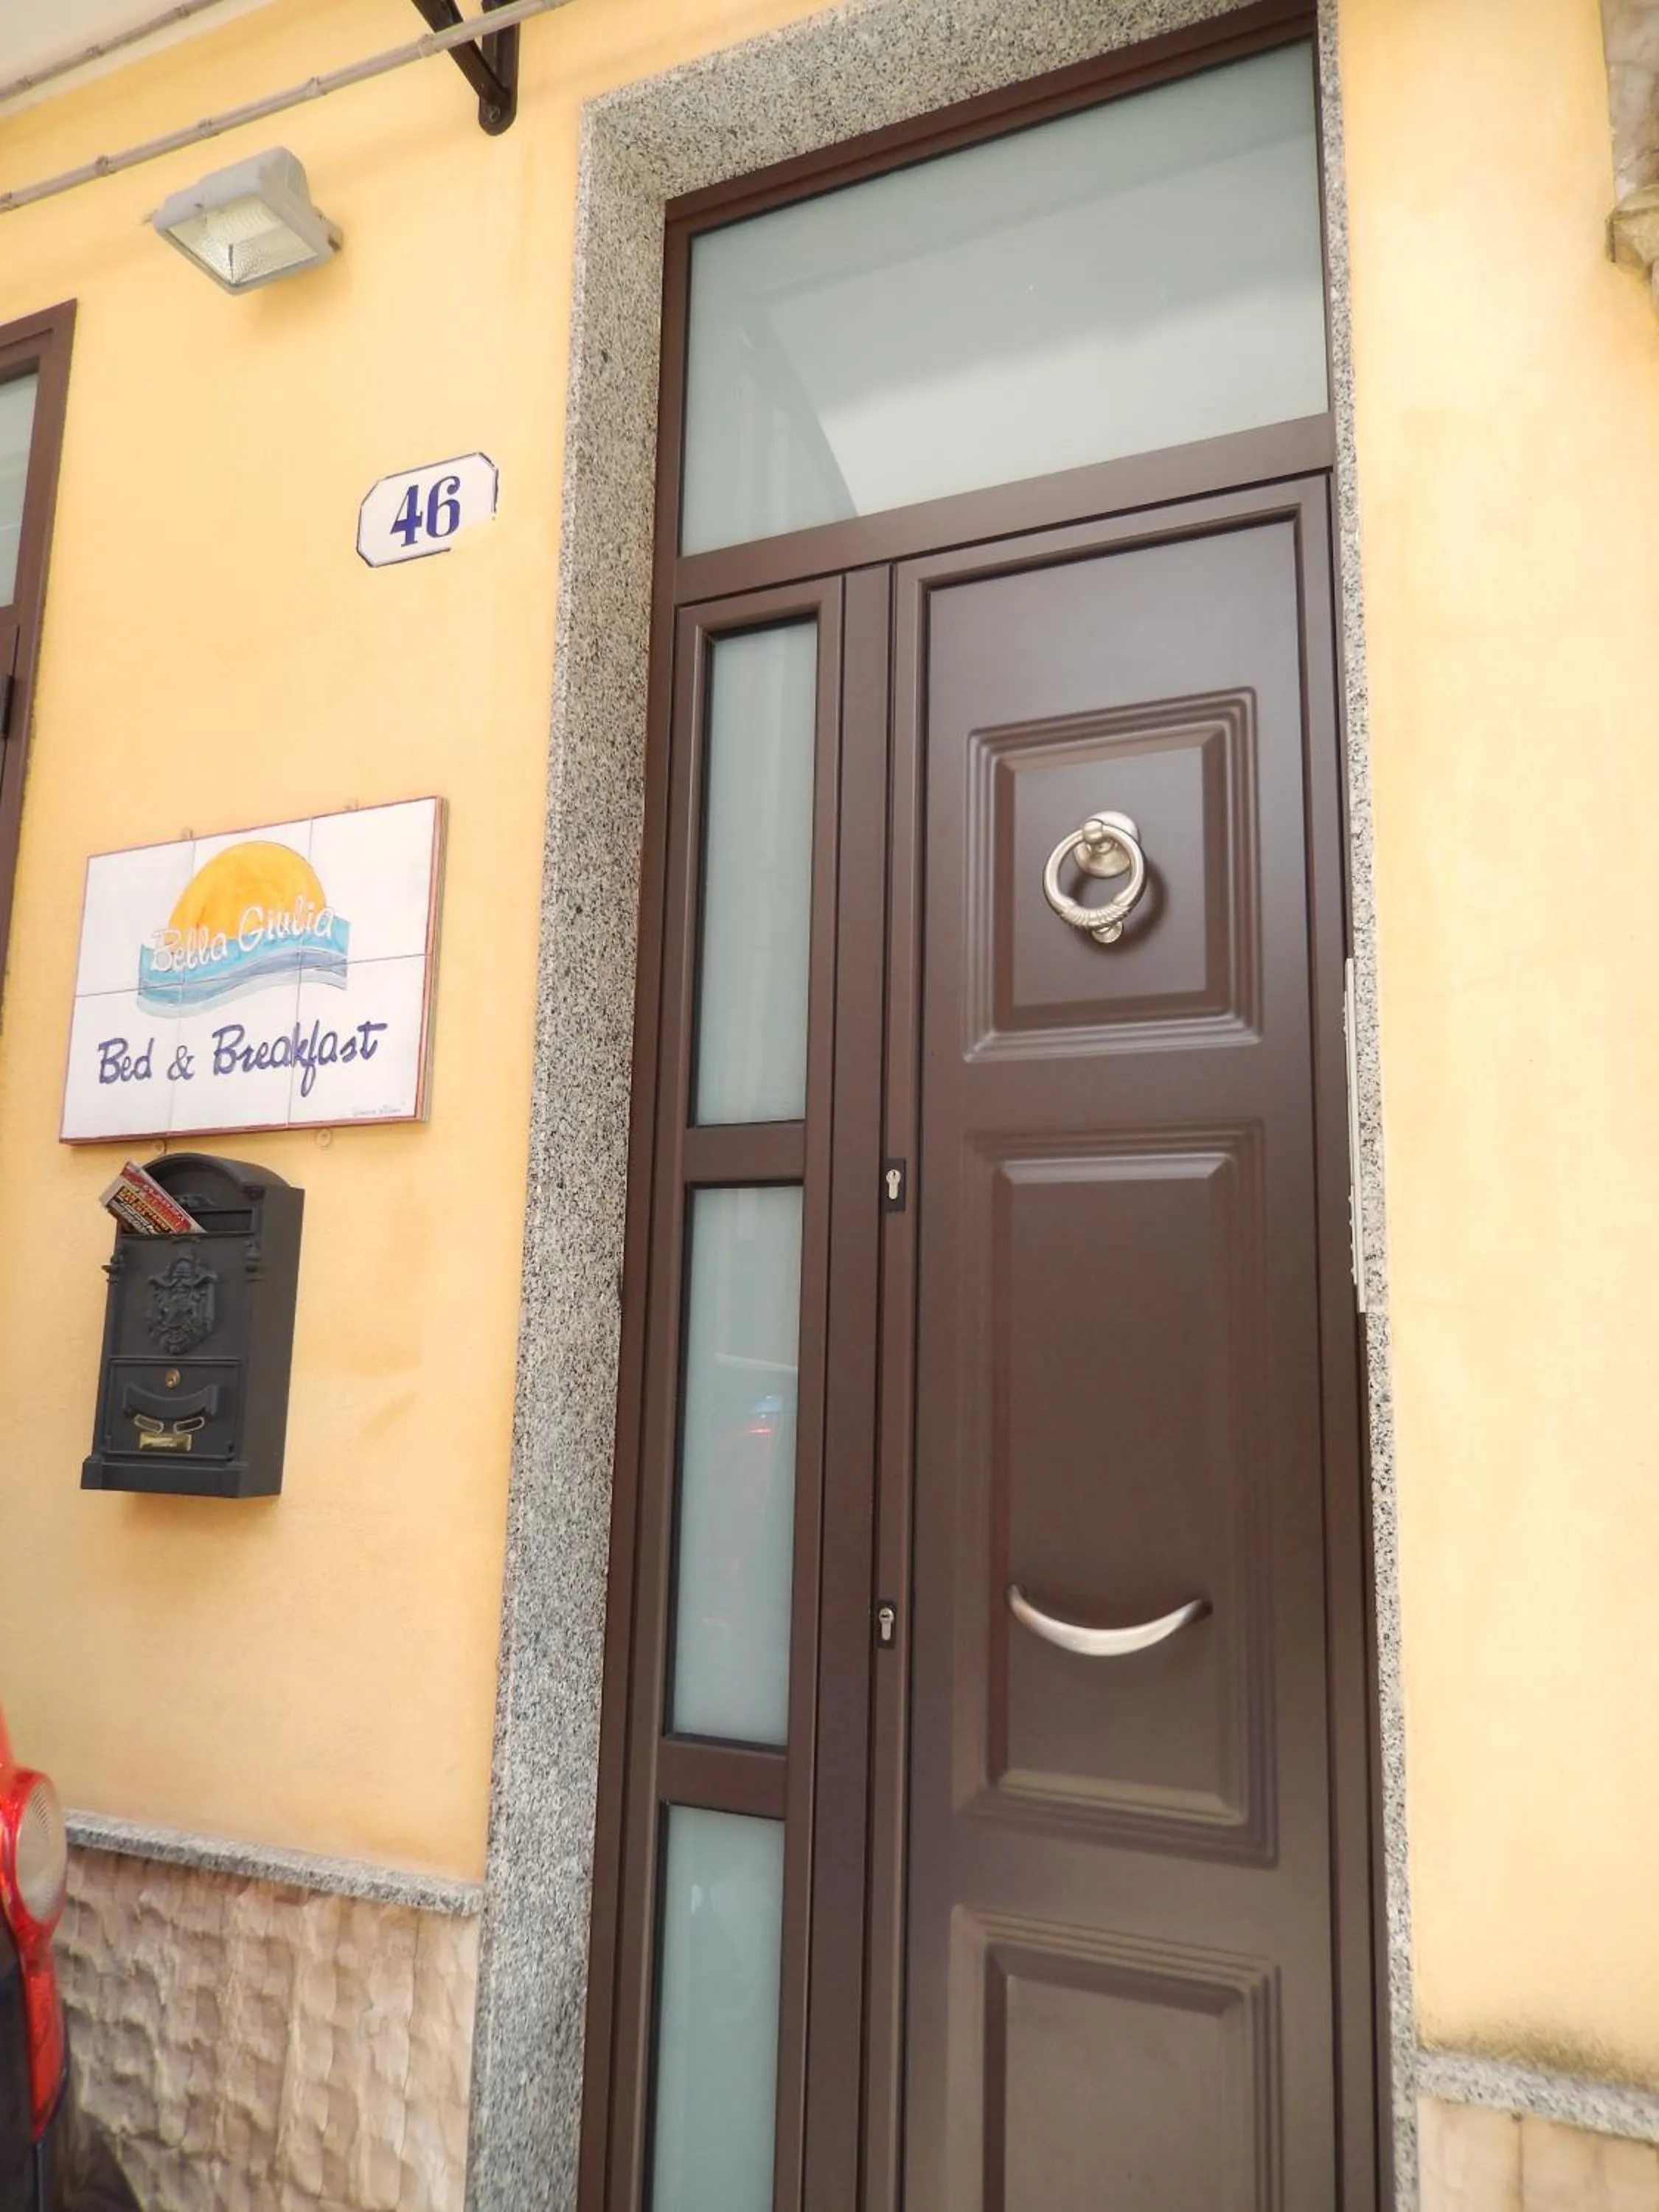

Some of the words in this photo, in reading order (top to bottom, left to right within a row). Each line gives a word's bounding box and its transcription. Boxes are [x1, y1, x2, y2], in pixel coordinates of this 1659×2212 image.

[389, 476, 460, 547] 46
[151, 925, 227, 972] Bella
[238, 895, 335, 951] Giulia
[98, 1037, 154, 1083] Bed
[167, 1045, 195, 1080] &
[212, 1020, 388, 1097] Breakfast
